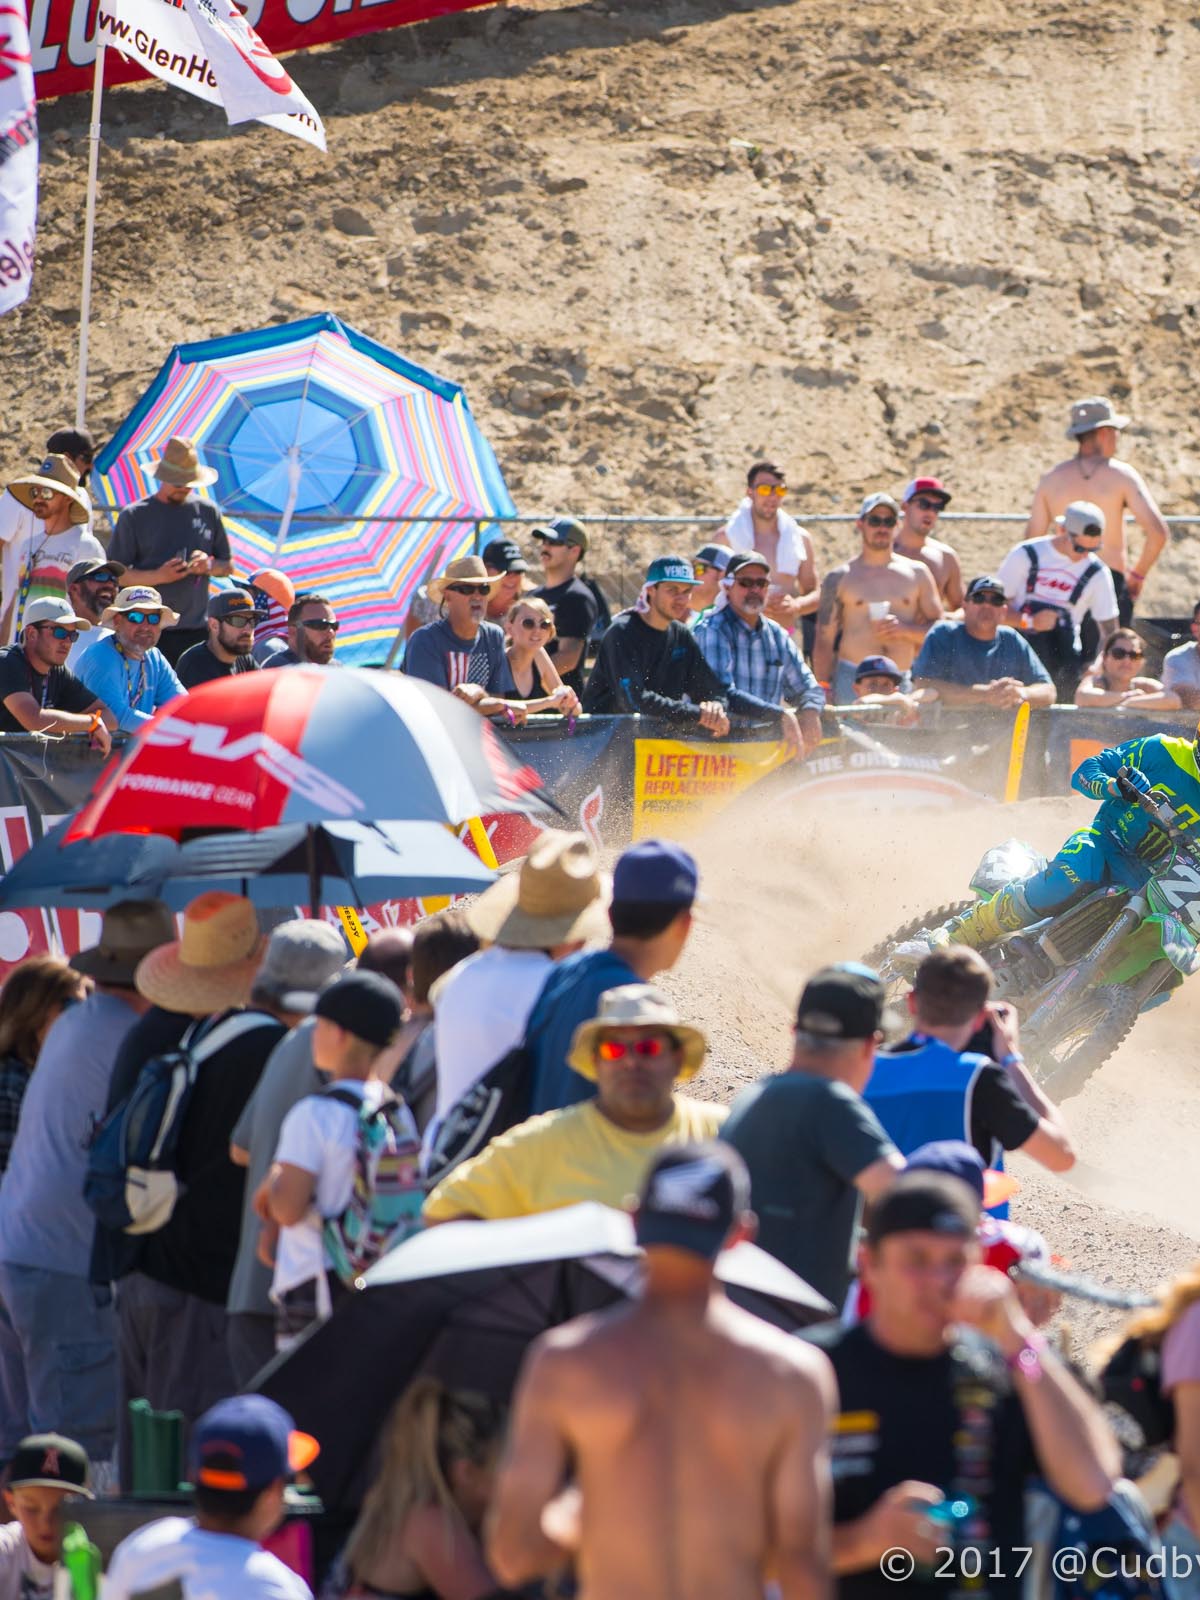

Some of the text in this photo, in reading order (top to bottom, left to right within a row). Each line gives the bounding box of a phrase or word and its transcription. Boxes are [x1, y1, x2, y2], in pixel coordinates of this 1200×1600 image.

[645, 754, 738, 779] LIFETIME
[806, 759, 844, 776] THE
[1060, 864, 1081, 884] FOX
